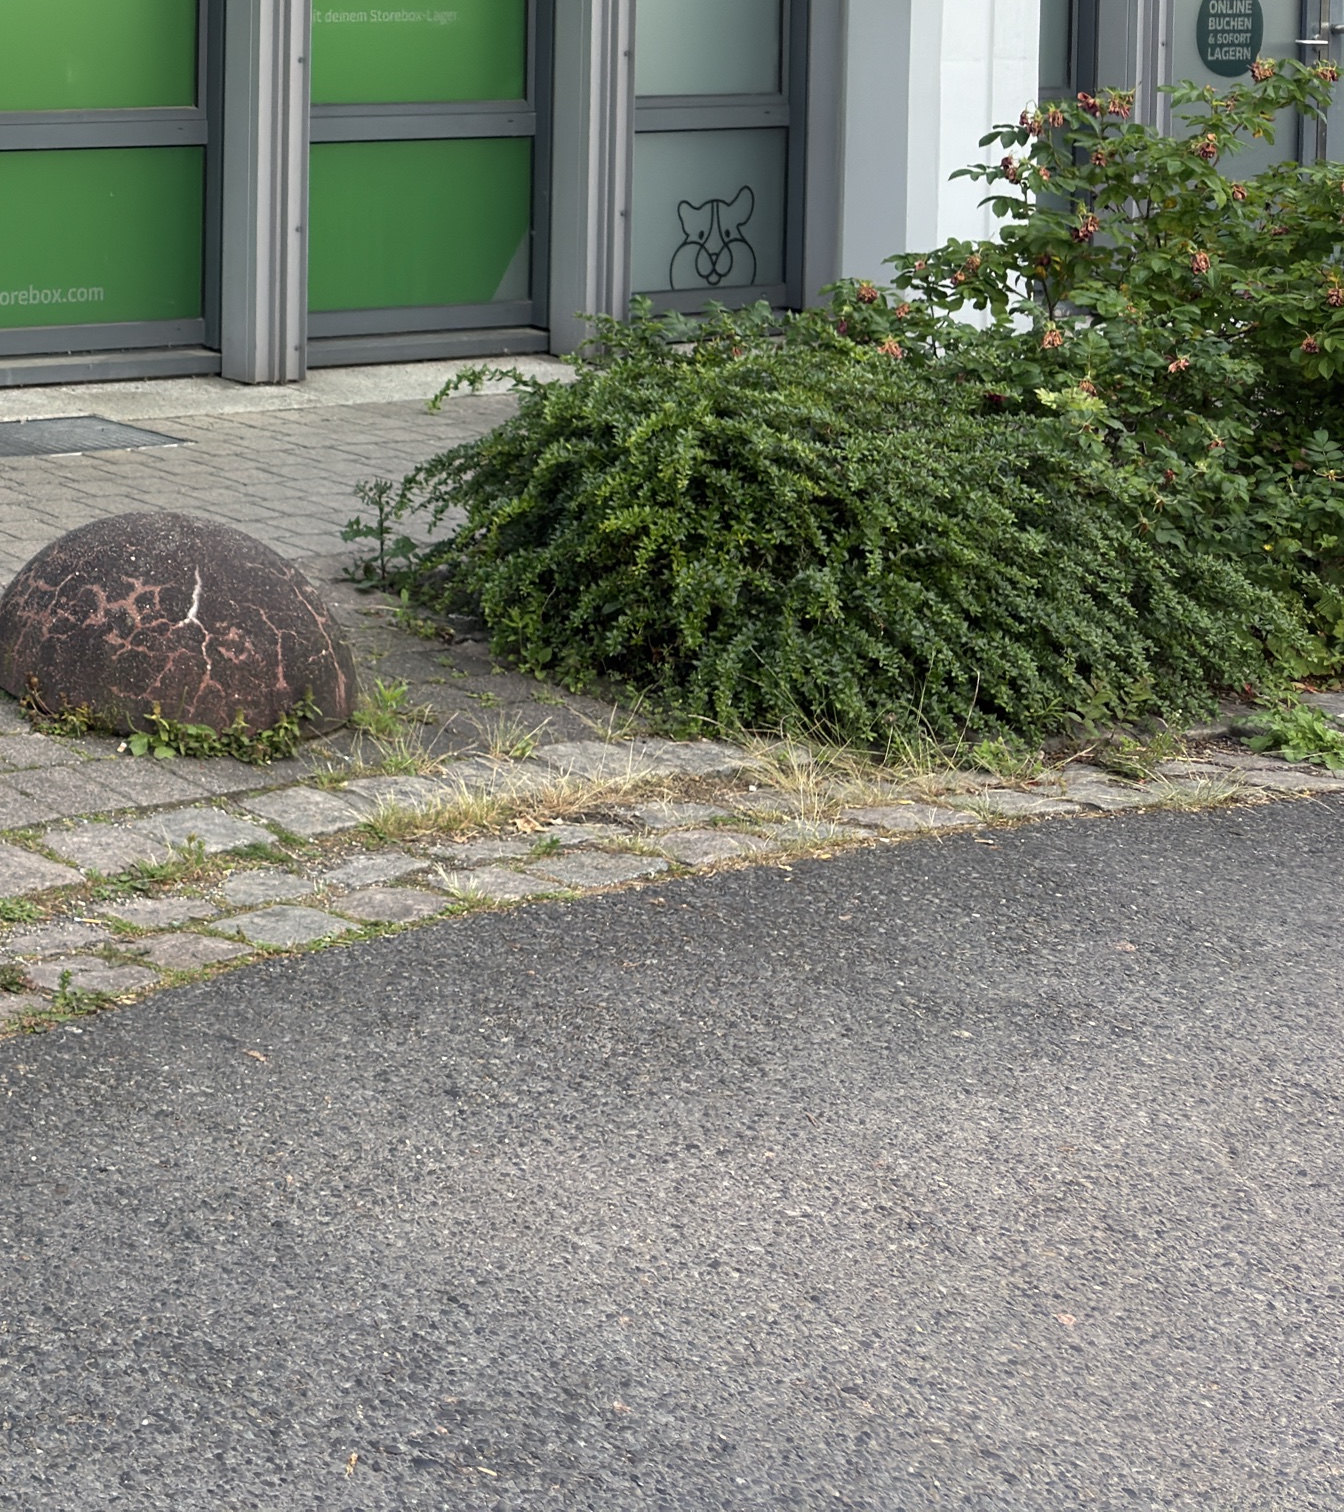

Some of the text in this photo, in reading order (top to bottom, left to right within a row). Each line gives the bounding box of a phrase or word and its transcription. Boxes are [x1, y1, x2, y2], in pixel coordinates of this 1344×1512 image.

[1209, 0, 1253, 14] ONLINE
[324, 9, 368, 23] deinem
[1208, 17, 1252, 31] BUCHEN
[1208, 33, 1252, 44] & SOFORT
[1207, 47, 1252, 61] LAGERN
